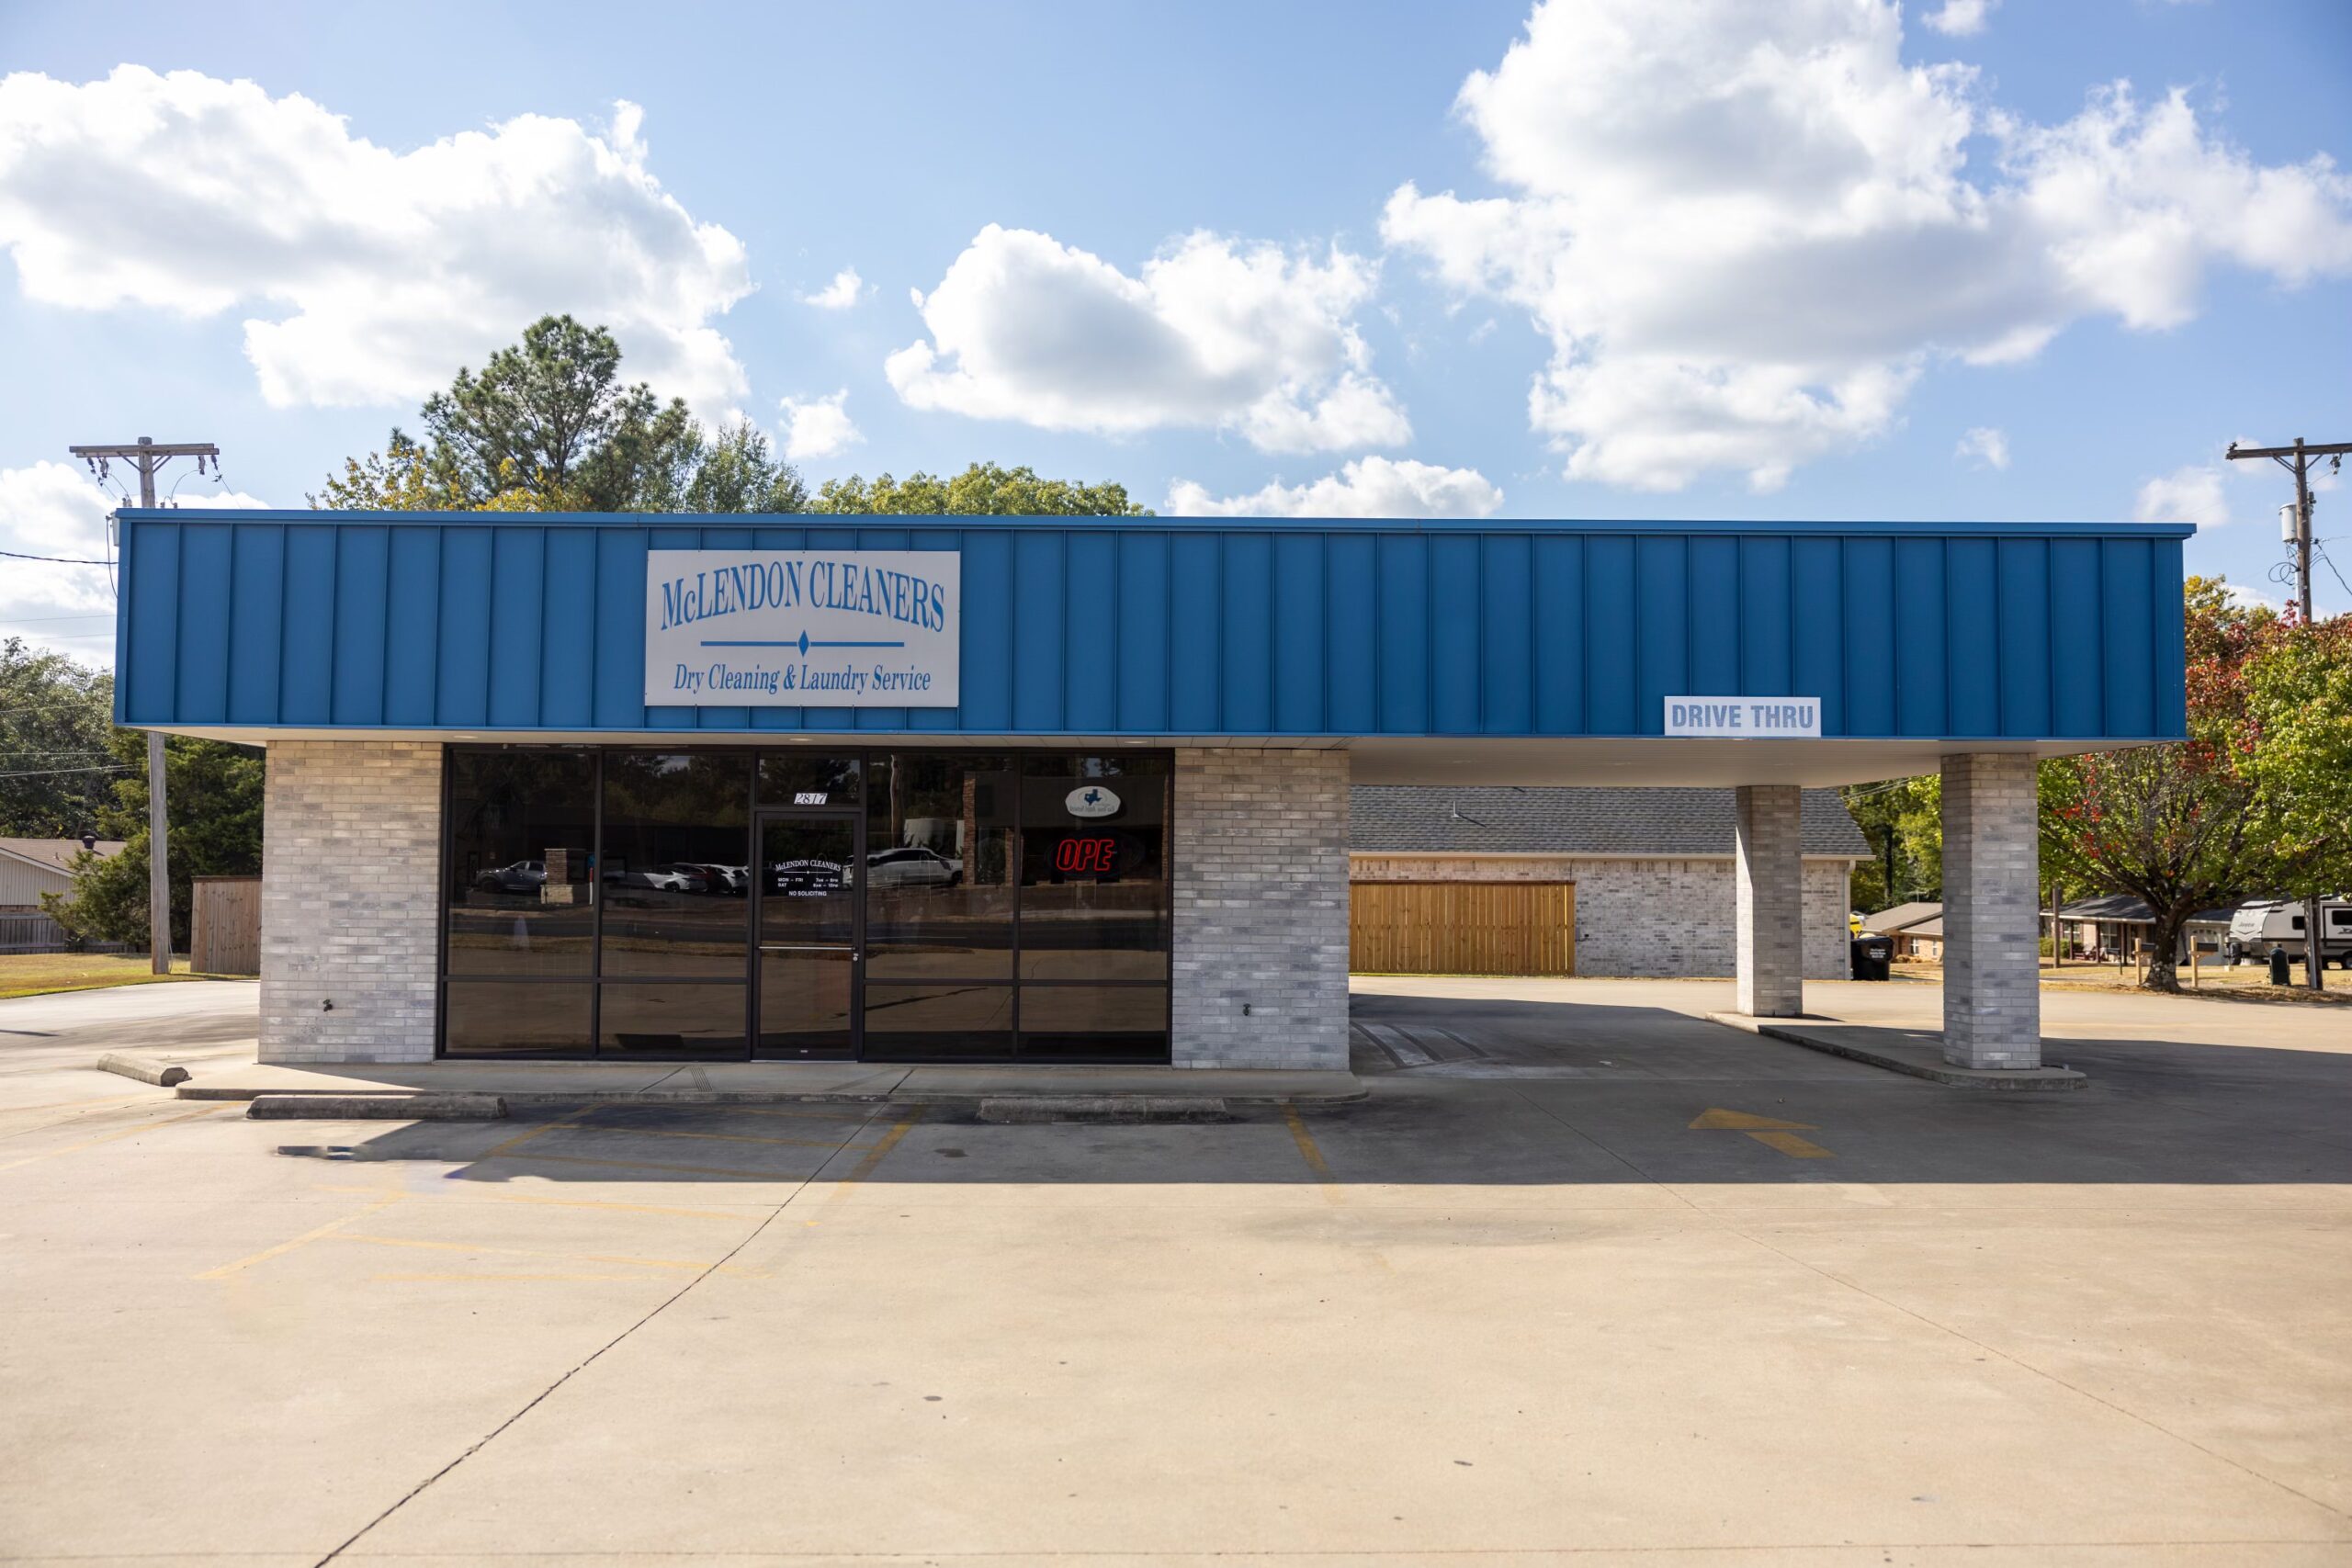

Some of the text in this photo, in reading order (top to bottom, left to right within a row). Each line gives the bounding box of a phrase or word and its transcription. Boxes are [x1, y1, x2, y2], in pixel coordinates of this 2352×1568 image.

[661, 560, 945, 632] McLENDON CLEANERS
[673, 663, 931, 694] Dry Cleaning & Laundry Service
[1672, 705, 1814, 728] DRIVE THRU
[795, 793, 827, 804] 2817
[775, 860, 842, 872] McLENDON CLEANERS
